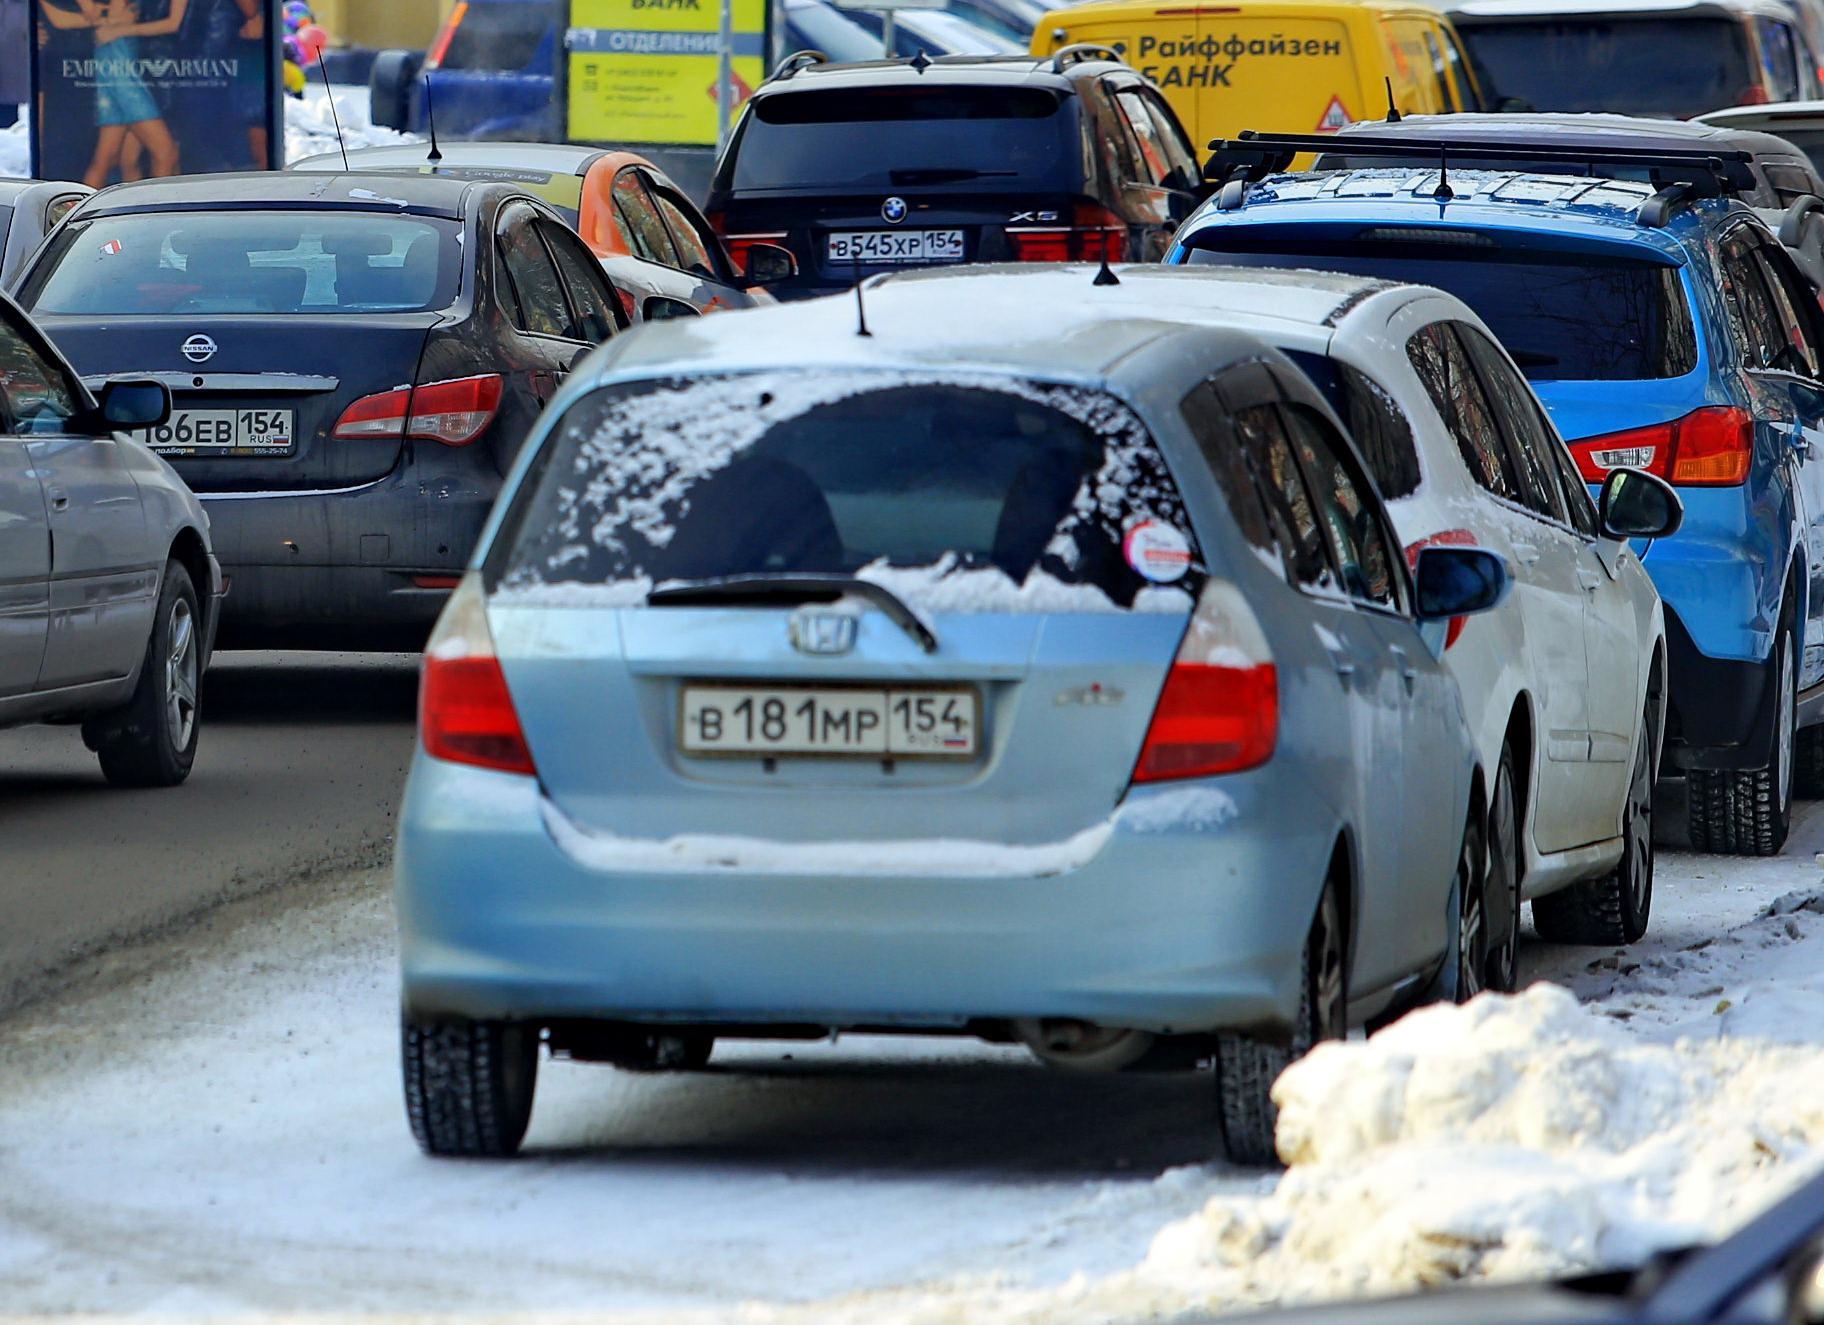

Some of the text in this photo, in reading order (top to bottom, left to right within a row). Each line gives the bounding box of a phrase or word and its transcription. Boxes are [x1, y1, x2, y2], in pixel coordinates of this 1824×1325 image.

[609, 31, 725, 52] ОТДЕЛЕНИ
[1139, 33, 1341, 62] Райффайзен
[62, 59, 239, 78] EMPORIO ARMANI
[926, 231, 961, 248] 154
[143, 411, 284, 443] 166ЕВ 154
[249, 434, 272, 444] RUS
[699, 695, 961, 743] В181МР 154
